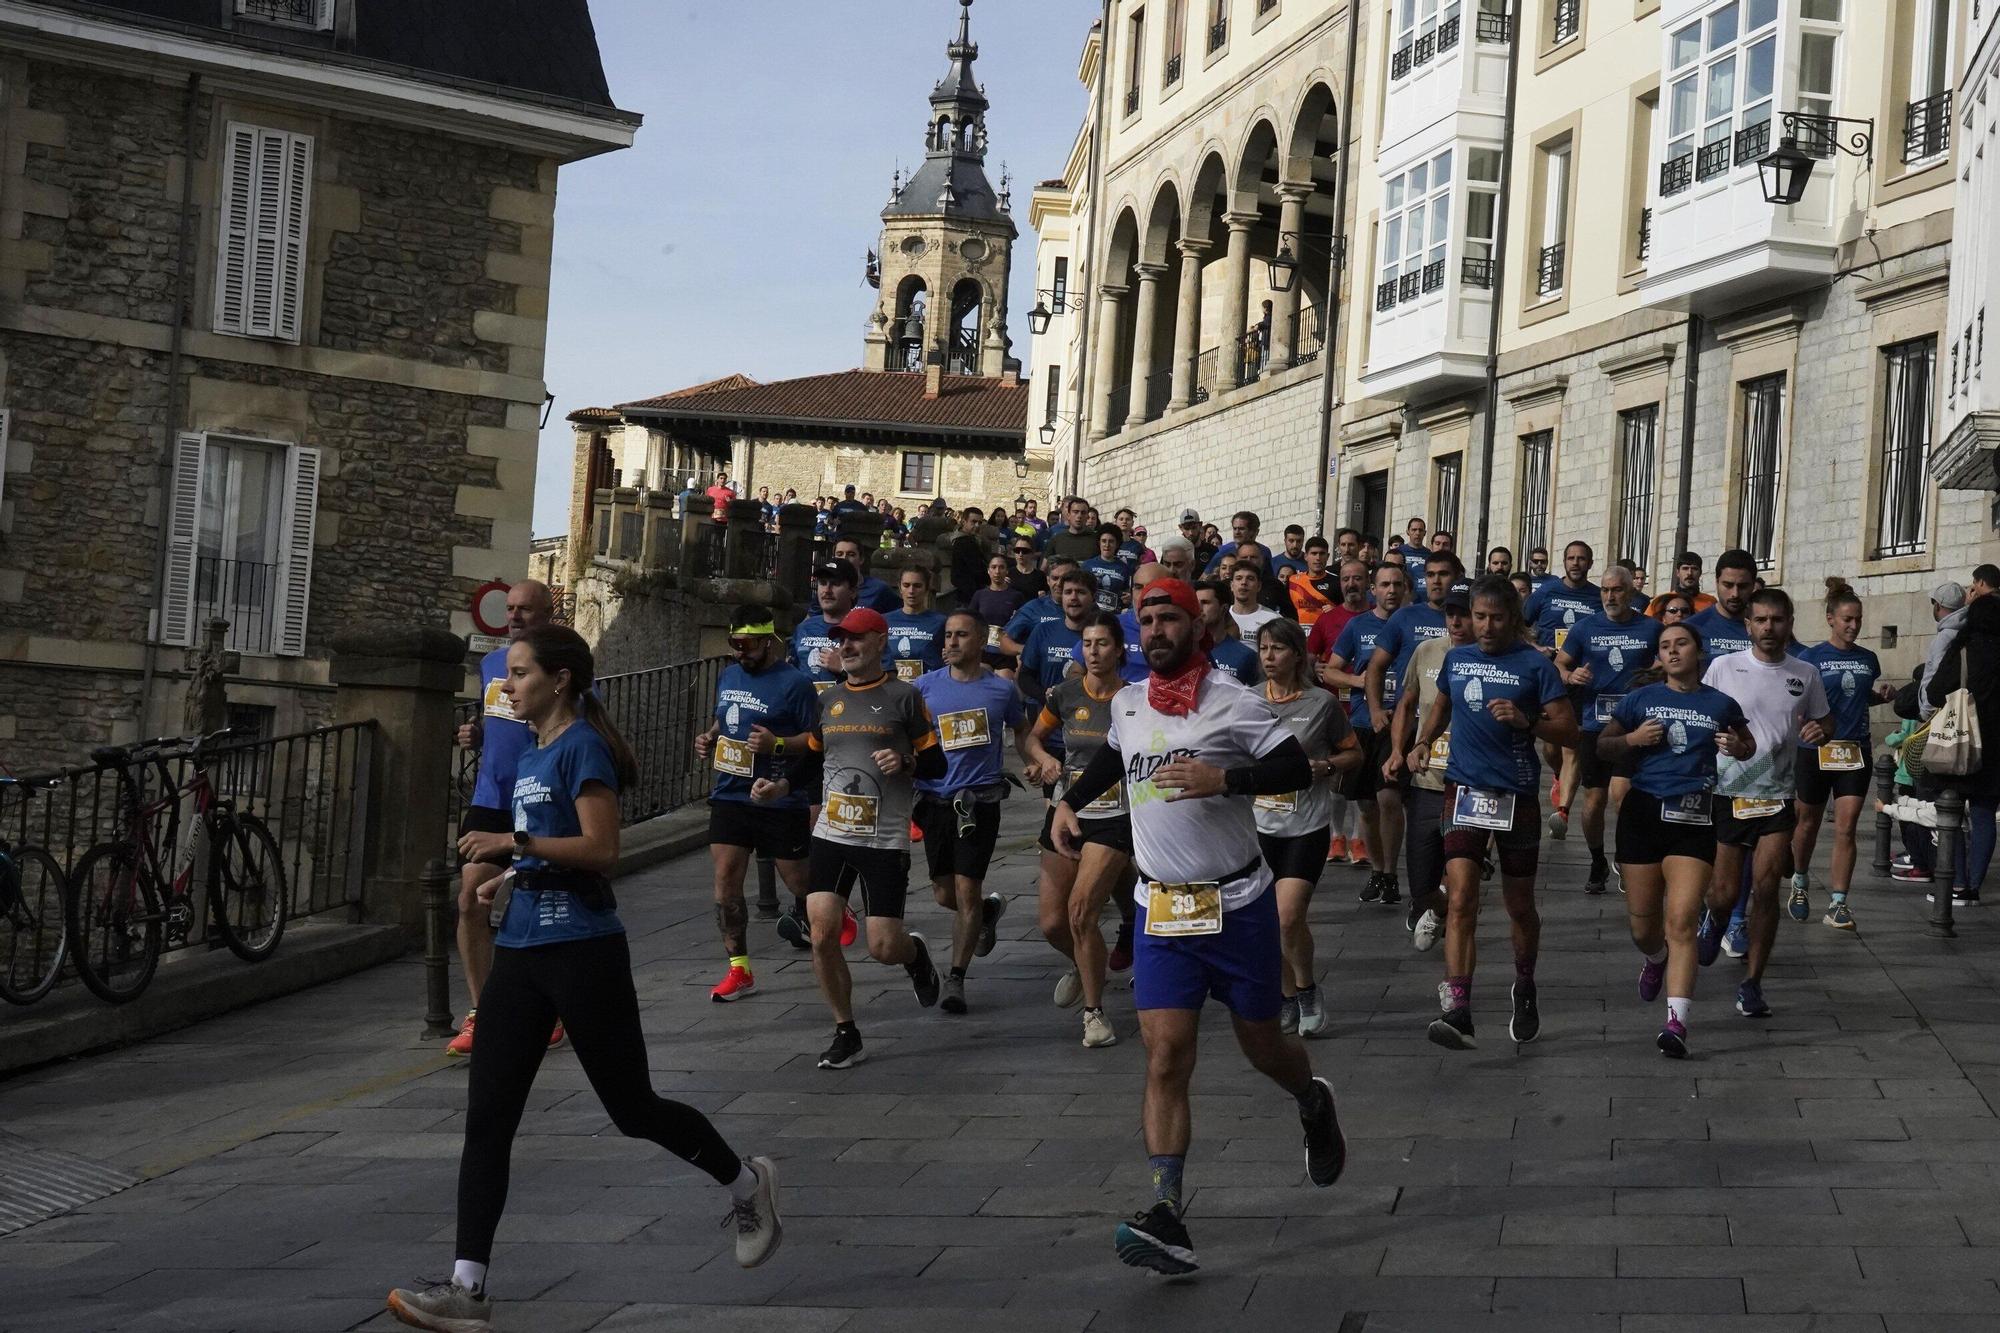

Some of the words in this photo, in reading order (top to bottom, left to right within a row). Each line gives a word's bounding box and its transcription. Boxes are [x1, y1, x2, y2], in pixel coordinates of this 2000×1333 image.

[1600, 639, 1640, 647] ALMENDRA
[1460, 662, 1497, 670] CONQUISTA
[1458, 667, 1510, 679] ALMENDRA
[1483, 676, 1520, 686] KONKISTA
[1655, 706, 1698, 715] CONQUISTA
[1656, 711, 1712, 724] ALMENDRA
[952, 719, 976, 736] 260
[1686, 720, 1720, 732] KONKISTA
[723, 746, 742, 763] 303
[1831, 748, 1852, 761] 434
[838, 803, 863, 821] 402
[1472, 797, 1499, 815] 753
[1171, 894, 1196, 915] 39
